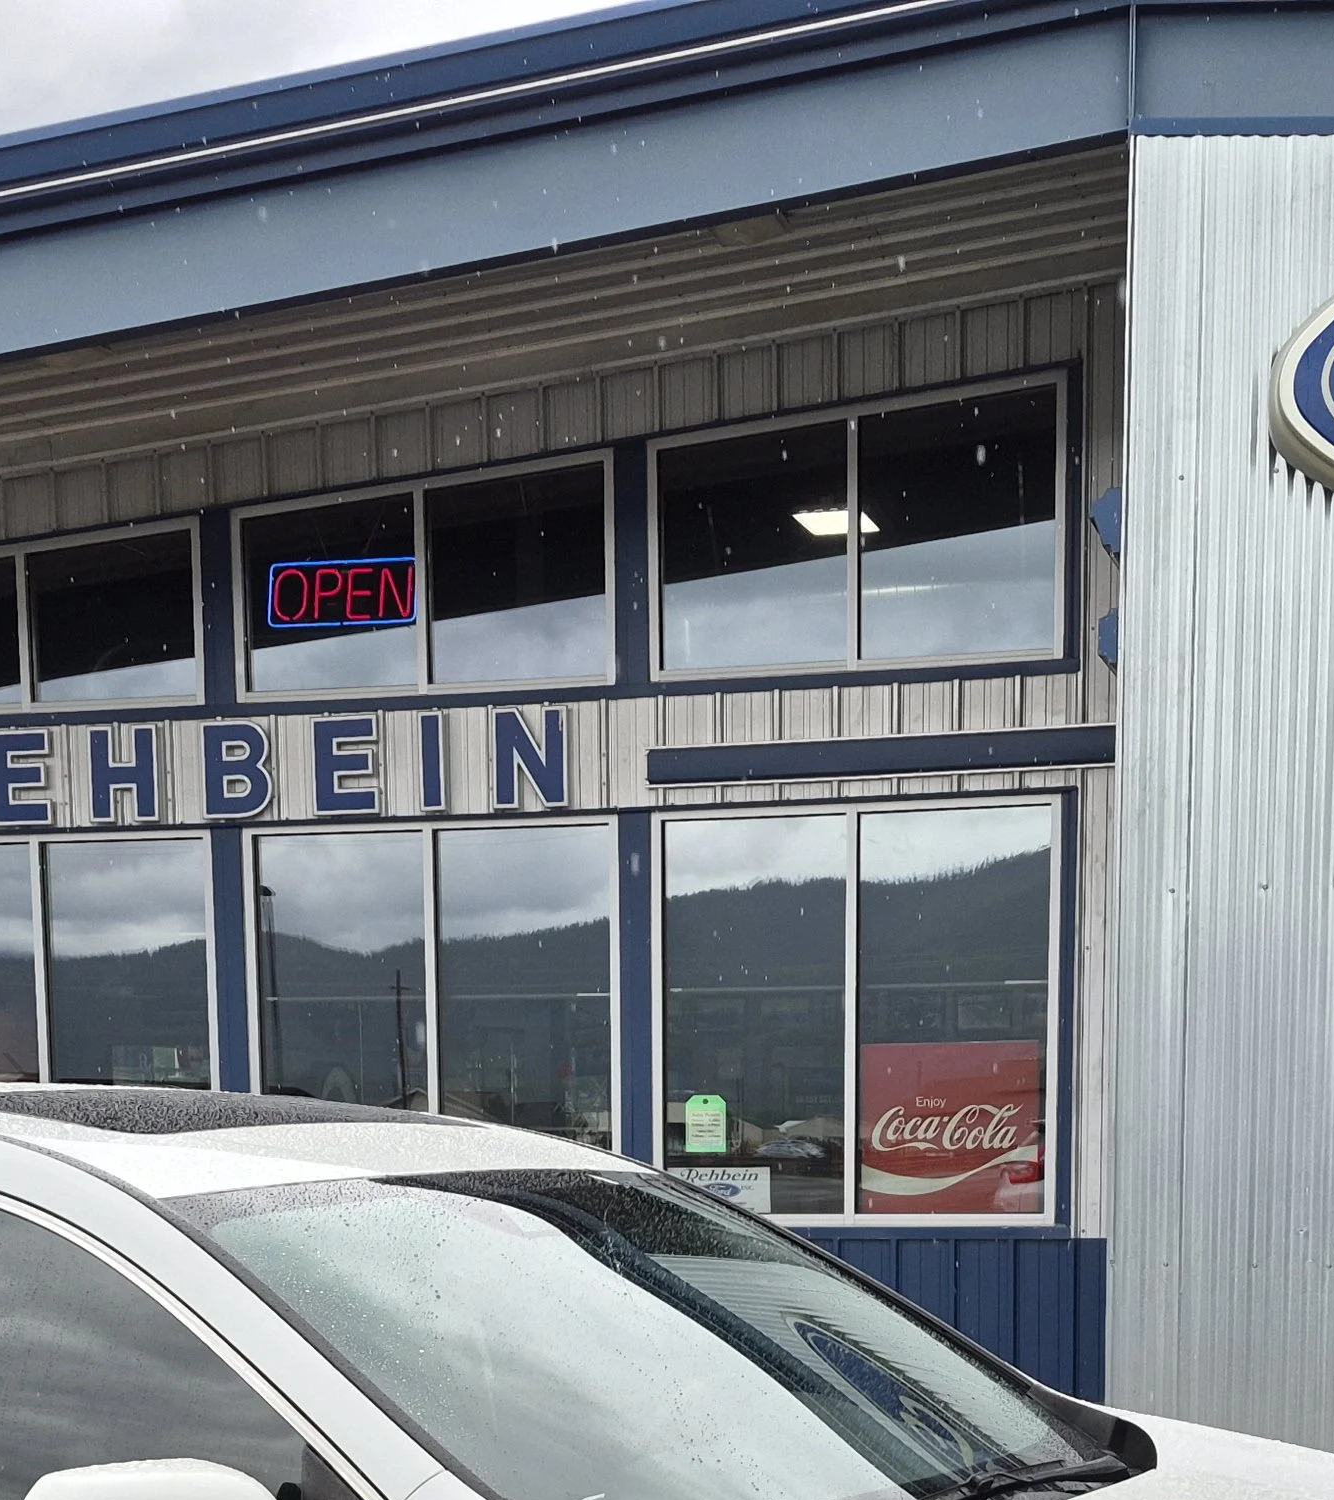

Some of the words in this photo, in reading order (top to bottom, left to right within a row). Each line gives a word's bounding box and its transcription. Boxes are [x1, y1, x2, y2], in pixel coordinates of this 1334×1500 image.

[273, 565, 414, 622] OPEN
[916, 1096, 947, 1109] Enjoy
[871, 1103, 1025, 1152] Coca-Cola
[680, 1168, 759, 1183] Rehbein
